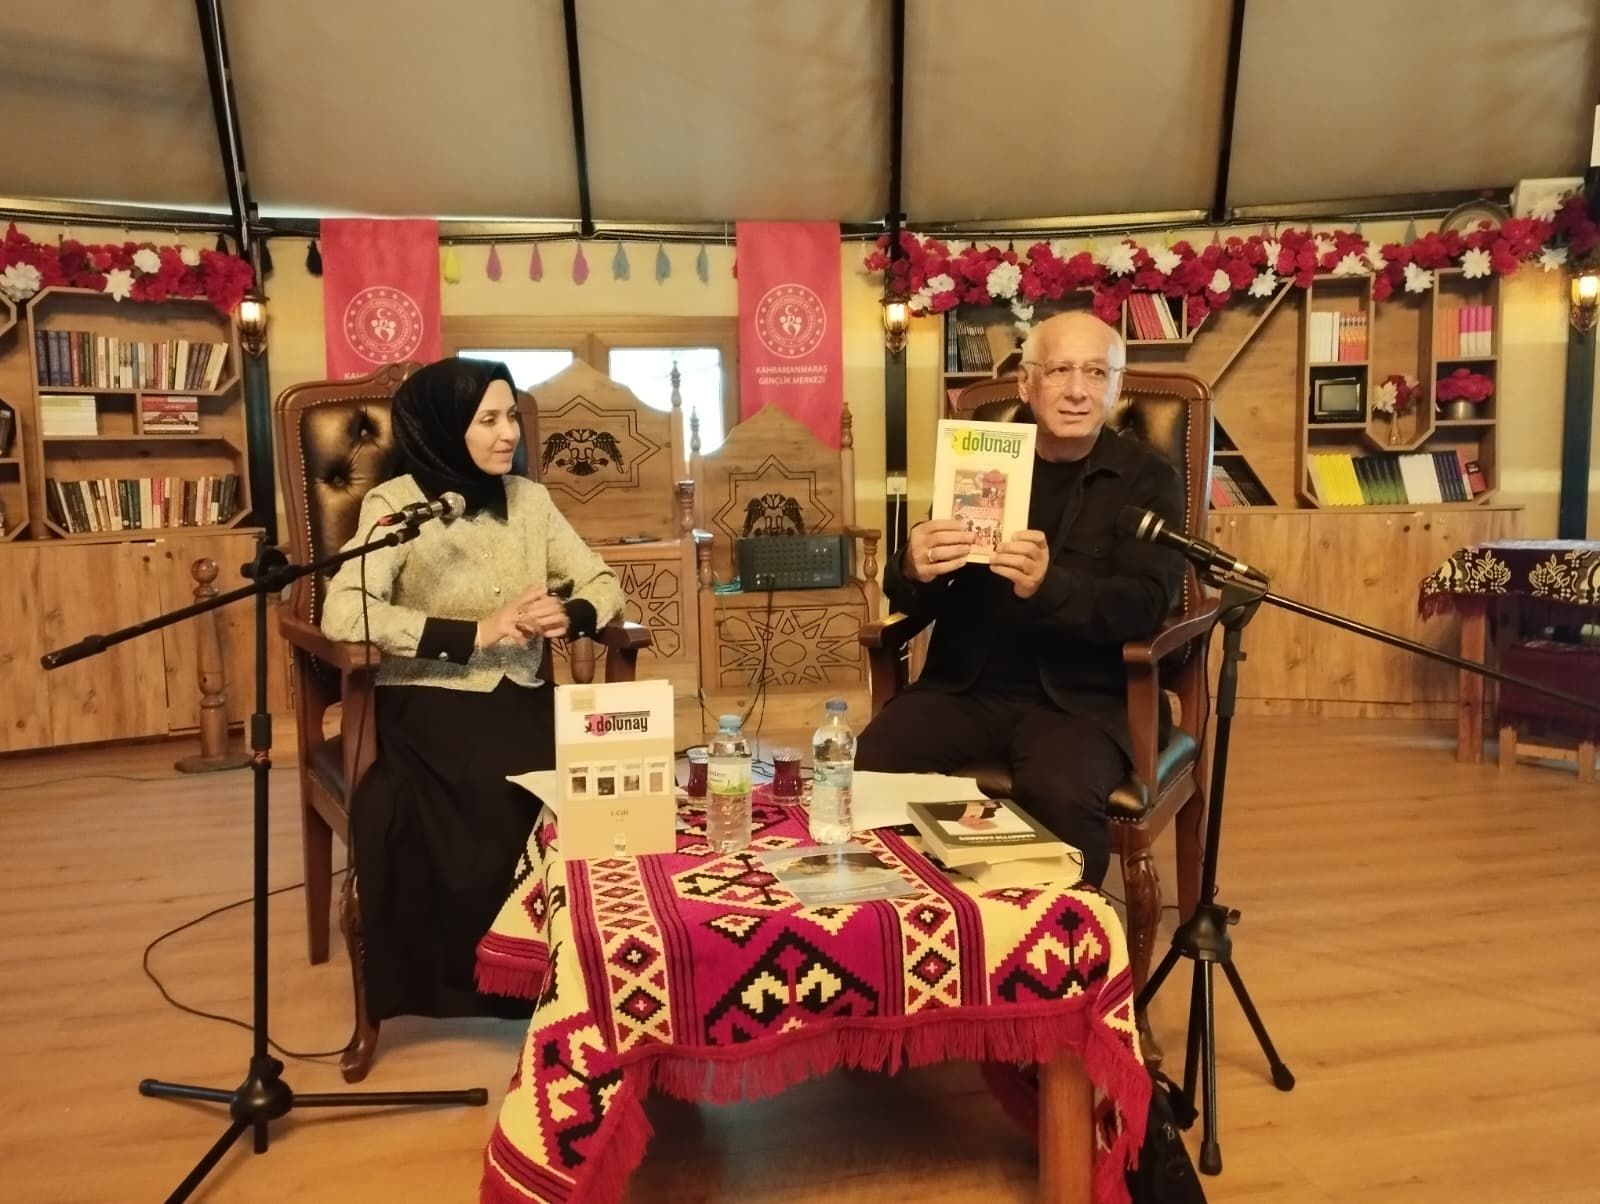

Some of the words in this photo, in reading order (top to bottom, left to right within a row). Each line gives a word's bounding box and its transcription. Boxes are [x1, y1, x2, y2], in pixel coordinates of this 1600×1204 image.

[755, 366, 828, 375] KAHRAMANMARAŞ
[758, 376, 791, 386] GENÇLİK
[792, 375, 826, 385] MERKEZİ
[962, 431, 1021, 459] dolunay
[596, 715, 648, 733] dolunay
